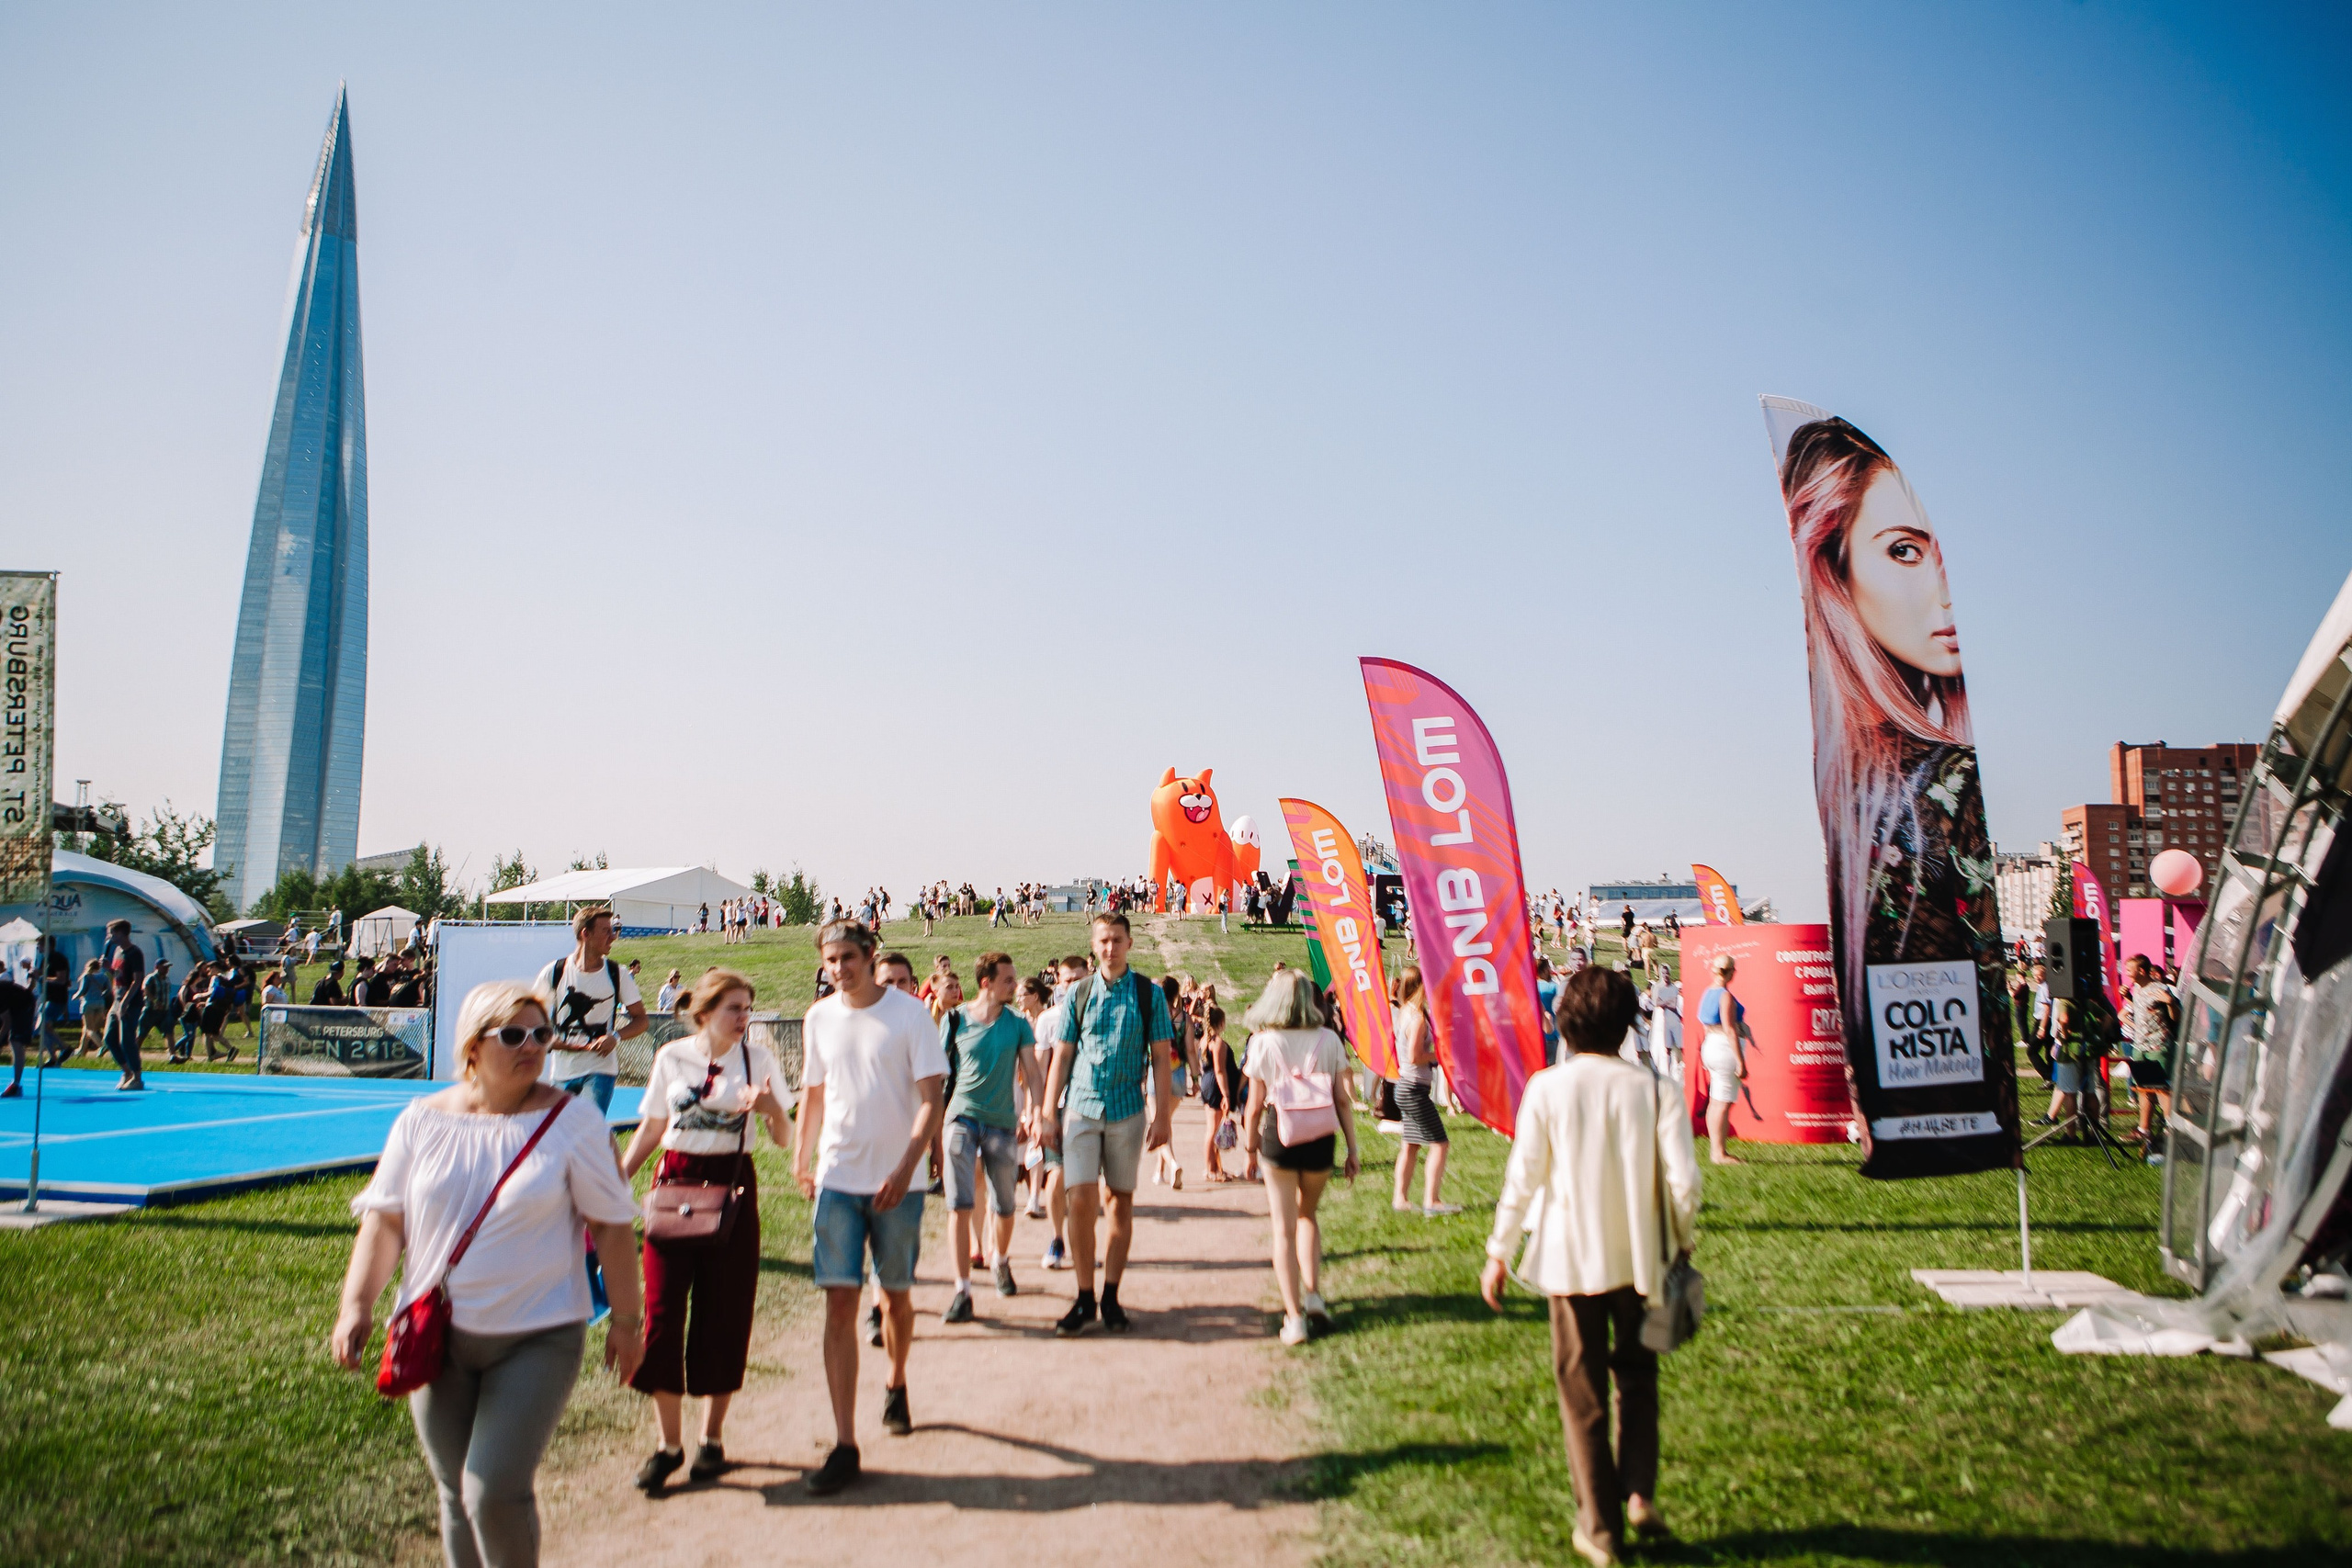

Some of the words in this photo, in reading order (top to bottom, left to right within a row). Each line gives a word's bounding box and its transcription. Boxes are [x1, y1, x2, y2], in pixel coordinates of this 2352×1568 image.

[322, 1025, 384, 1039] PETERSBURG
[284, 1039, 341, 1057] OPEN
[350, 1040, 407, 1059] 2018
[1888, 1062, 1922, 1083] Hair
